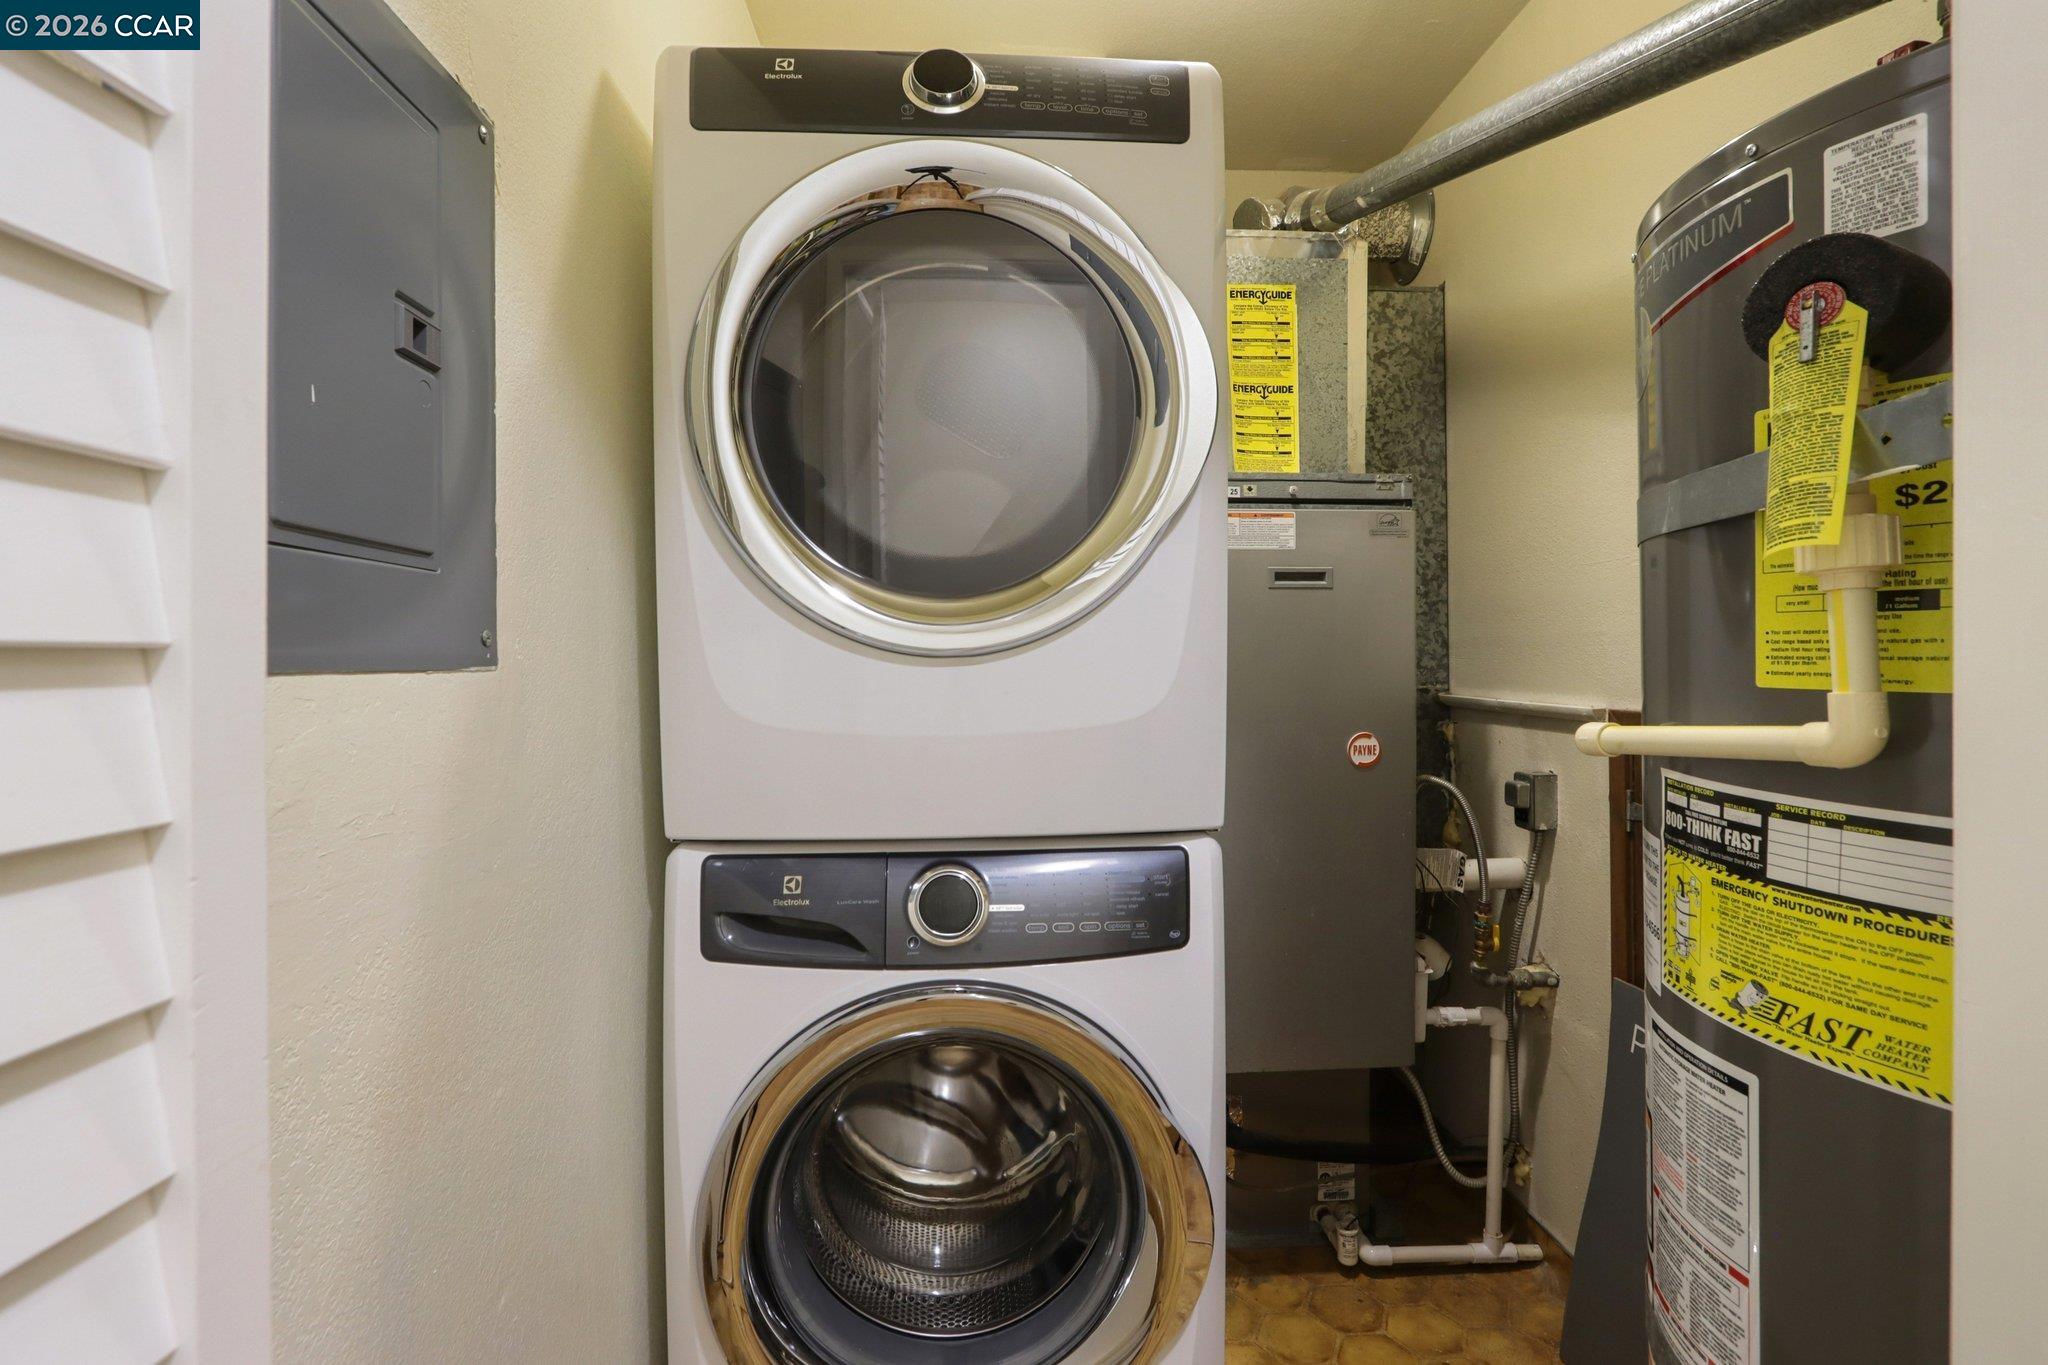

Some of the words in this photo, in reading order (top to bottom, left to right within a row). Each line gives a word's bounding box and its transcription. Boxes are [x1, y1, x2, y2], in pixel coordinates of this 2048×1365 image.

[1230, 290, 1292, 301] ENERGYGUIDE
[1233, 384, 1294, 395] ENERGYGUIDE
[1353, 744, 1377, 757] PAYNE
[1694, 786, 1715, 797] RECORD
[1776, 803, 1809, 816] SERVICE
[1810, 810, 1846, 822] RECORD
[1666, 809, 1722, 843] 800-THINK
[1724, 827, 1763, 853] FAST
[1809, 819, 1826, 828] DATE
[1843, 825, 1886, 837] DESCRIPTION
[1457, 856, 1466, 889] GAS
[1705, 860, 1728, 871] HEATER
[773, 898, 810, 907] Electrolux
[1711, 877, 1769, 903] EMERGENCY
[1772, 896, 1848, 924] SHUTDOWN
[1752, 922, 1773, 933] WATER
[1769, 996, 1873, 1052] FAST
[1845, 1000, 1868, 1014] SAME
[1870, 1009, 1888, 1019] DAY
[1889, 1015, 1929, 1031] SERVICE
[1882, 1034, 1932, 1054] WATER
[1862, 1049, 1931, 1075] COMPANY
[1877, 1043, 1932, 1065] HEATER
[1707, 1066, 1728, 1083] DETAILS
